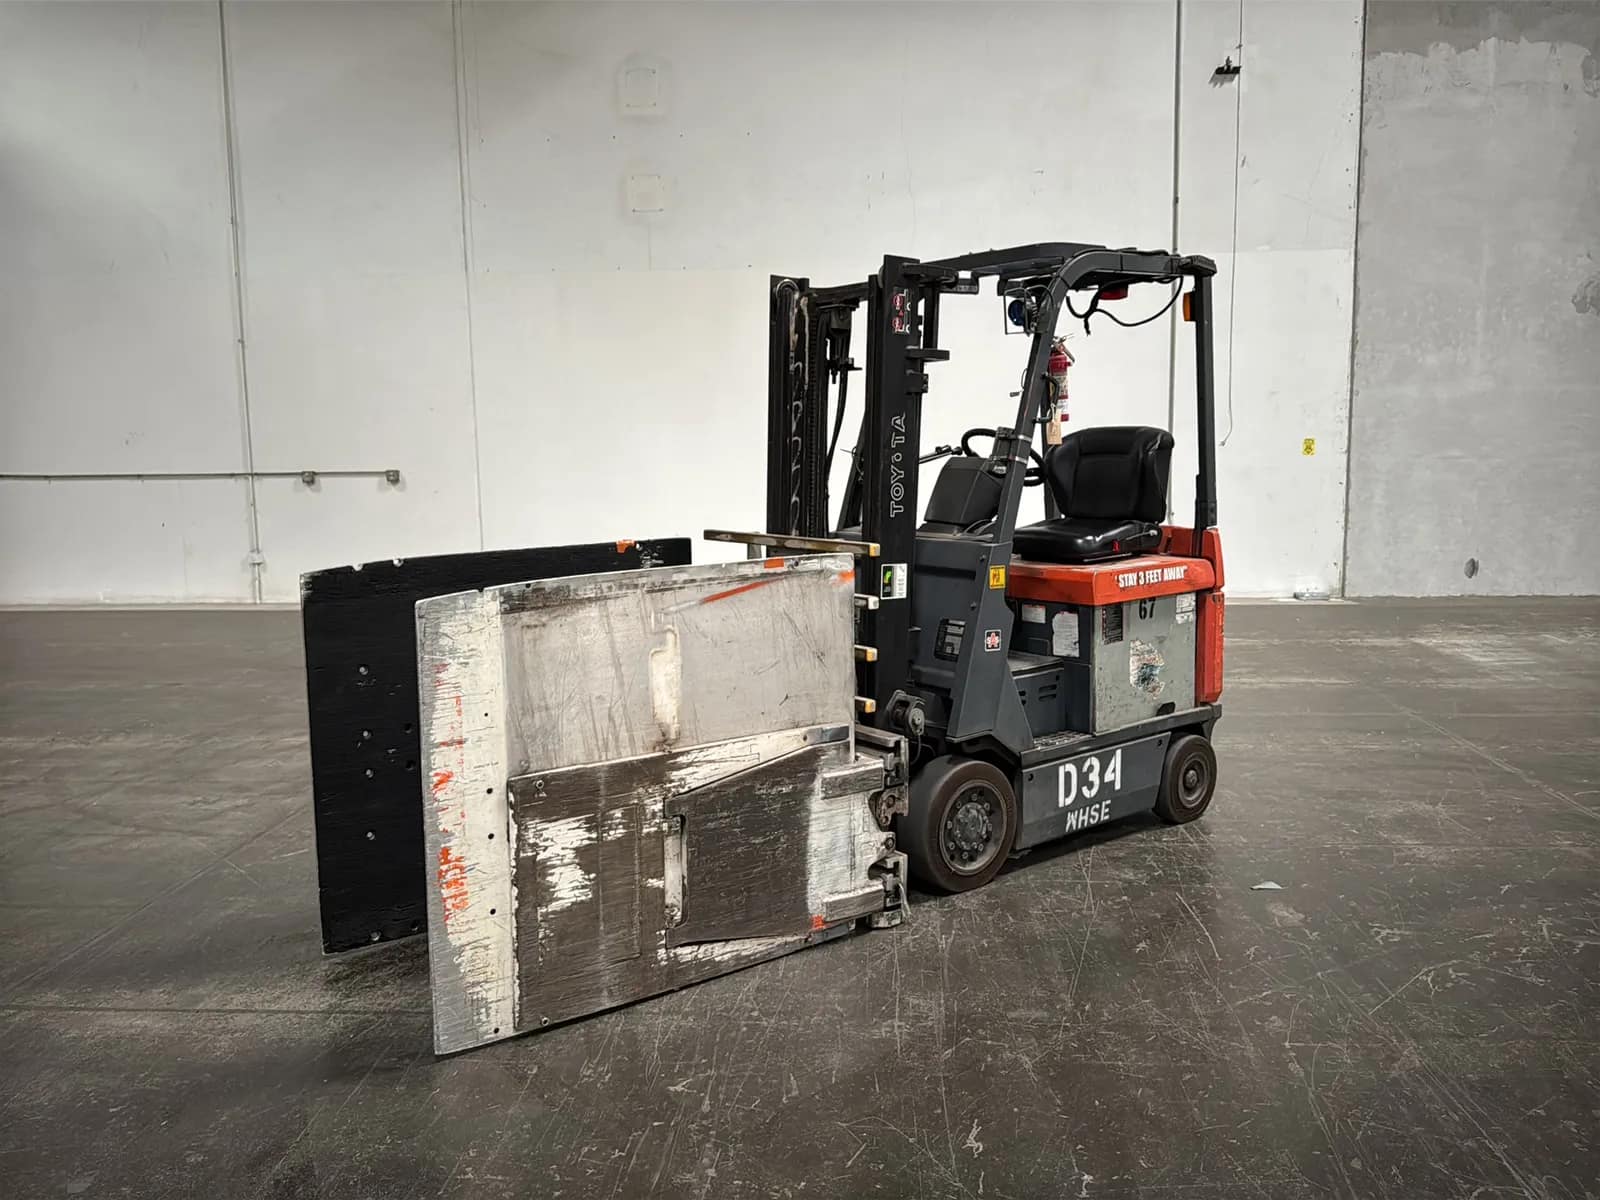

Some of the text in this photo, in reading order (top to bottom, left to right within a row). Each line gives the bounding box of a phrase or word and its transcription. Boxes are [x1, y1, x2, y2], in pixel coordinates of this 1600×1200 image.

[889, 411, 906, 518] TOYOTA
[1138, 571, 1146, 585] 3
[1145, 568, 1162, 585] FEET
[1138, 597, 1156, 620] 67
[1058, 748, 1122, 808] D34
[1065, 799, 1112, 833] WHSE
